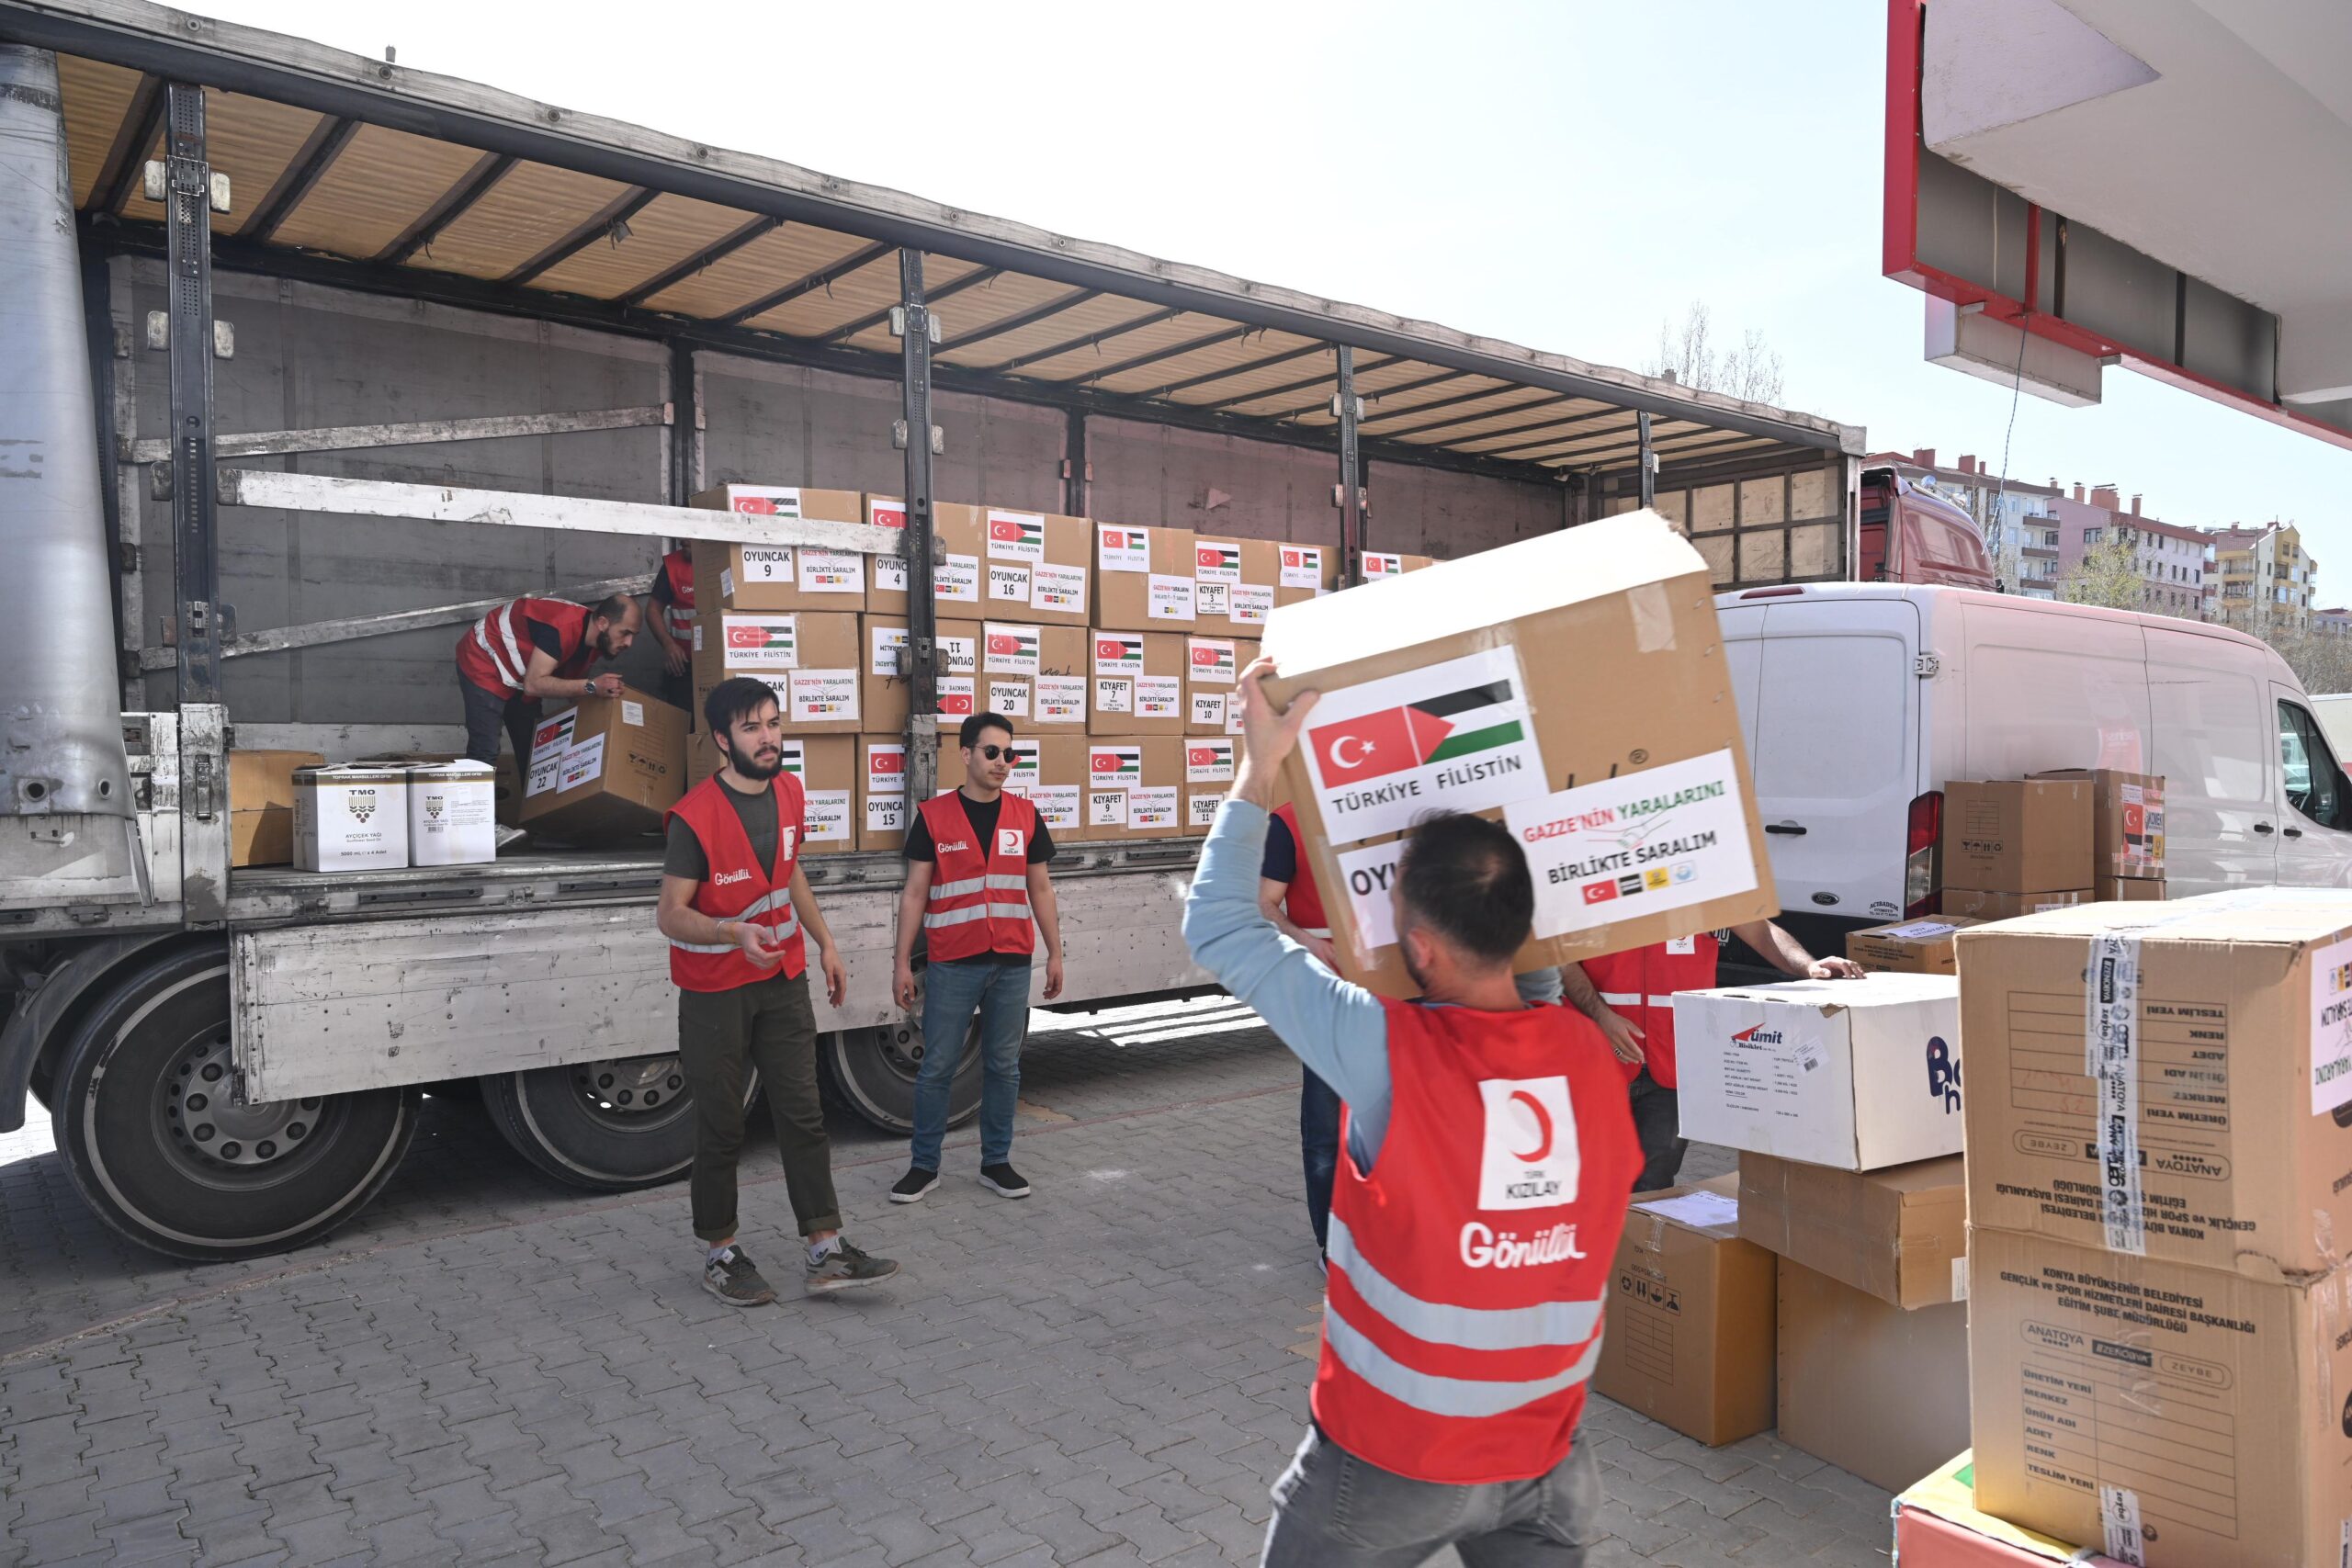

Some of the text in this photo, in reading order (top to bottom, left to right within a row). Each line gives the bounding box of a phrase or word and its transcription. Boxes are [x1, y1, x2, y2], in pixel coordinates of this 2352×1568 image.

[990, 543, 1040, 554] TÜRKİYE FİLİSTİN
[744, 550, 790, 562] OYUNCAK
[764, 564, 772, 577] 9
[877, 559, 908, 571] OYUNC
[894, 573, 901, 585] 4
[952, 577, 972, 585] SARALIM
[990, 571, 1028, 583] OYUNCAK
[1003, 584, 1014, 595] 16
[1058, 587, 1079, 595] SARALIM
[1199, 586, 1224, 594] KIYAFET
[1210, 594, 1215, 603] 3
[989, 656, 1035, 666] TÜRKİYE FİLİSTİN
[990, 686, 1027, 698] OYUNCAK
[1100, 681, 1128, 691] KIYAFET
[798, 694, 825, 703] BİRLİKTE
[1195, 699, 1221, 709] KIYAFET
[1003, 700, 1014, 711] 20
[1204, 711, 1213, 719] 10
[529, 761, 558, 779] OYUNCAK
[537, 776, 547, 789] 22
[872, 775, 897, 784] TÜRKİYE
[1332, 755, 1522, 814] TÜRKİYE FİLİSTİN
[815, 797, 846, 806] YARALARINI
[1093, 794, 1123, 805] KIYAFET
[1193, 800, 1218, 809] KIYAFET
[867, 801, 904, 812] OYUNCA
[1105, 804, 1110, 812] 9
[1523, 780, 1725, 843] GAZZE'NİN YARALARINI
[817, 814, 842, 822] SARALIM
[882, 814, 896, 826] 15
[1202, 813, 1209, 822] 11
[937, 840, 969, 853] Gönüllü
[1547, 830, 1718, 885] BİRLİKTE SARALIM
[715, 869, 752, 886] Gönüllü
[2146, 1006, 2224, 1018] TESLİM YERİ
[1751, 1029, 1782, 1044] ümit
[2190, 1031, 2224, 1040] RENK
[1738, 1042, 1762, 1051] Bisiklet
[2191, 1051, 2225, 1060] ADET
[2165, 1069, 2187, 1077] ADI
[2174, 1091, 2226, 1104] MERKEZ
[2146, 1108, 2227, 1125] ÜRETİM YERİ
[2030, 1139, 2067, 1151] ZEYBE
[2155, 1159, 2222, 1176] ANATOYA
[1506, 1181, 1562, 1199] KIZILAY
[1996, 1183, 2256, 1231] GENÇLİK ve SPOR DAİRESİ BAŞKANLIĞI
[2150, 1194, 2187, 1209] EĞİTİM
[2041, 1203, 2205, 1240] KONYA BELEDİYESİ
[1459, 1221, 1588, 1269] Gönüllü
[2043, 1268, 2203, 1309] KONYA BÜYÜKŞEHİR BELEDİYESİ
[2000, 1271, 2256, 1334] GENÇLİK ve SPOR HİZMETLERİ DAİRESİ BAŞKANLIĞI
[2058, 1297, 2188, 1334] EĞİTİM ŞUBE MÜDÜRLÜĞÜ
[2028, 1325, 2084, 1346] ANATOYA
[2172, 1362, 2212, 1378] ZEYBE
[2023, 1369, 2092, 1394] ÜRETİM YERİ
[2024, 1387, 2068, 1405] MERKEZ
[2025, 1406, 2076, 1427] ÜRÜN ADI
[2026, 1426, 2053, 1439] ADET
[2027, 1444, 2056, 1459] RENK
[2027, 1464, 2095, 1490] TESLİM YERİ
